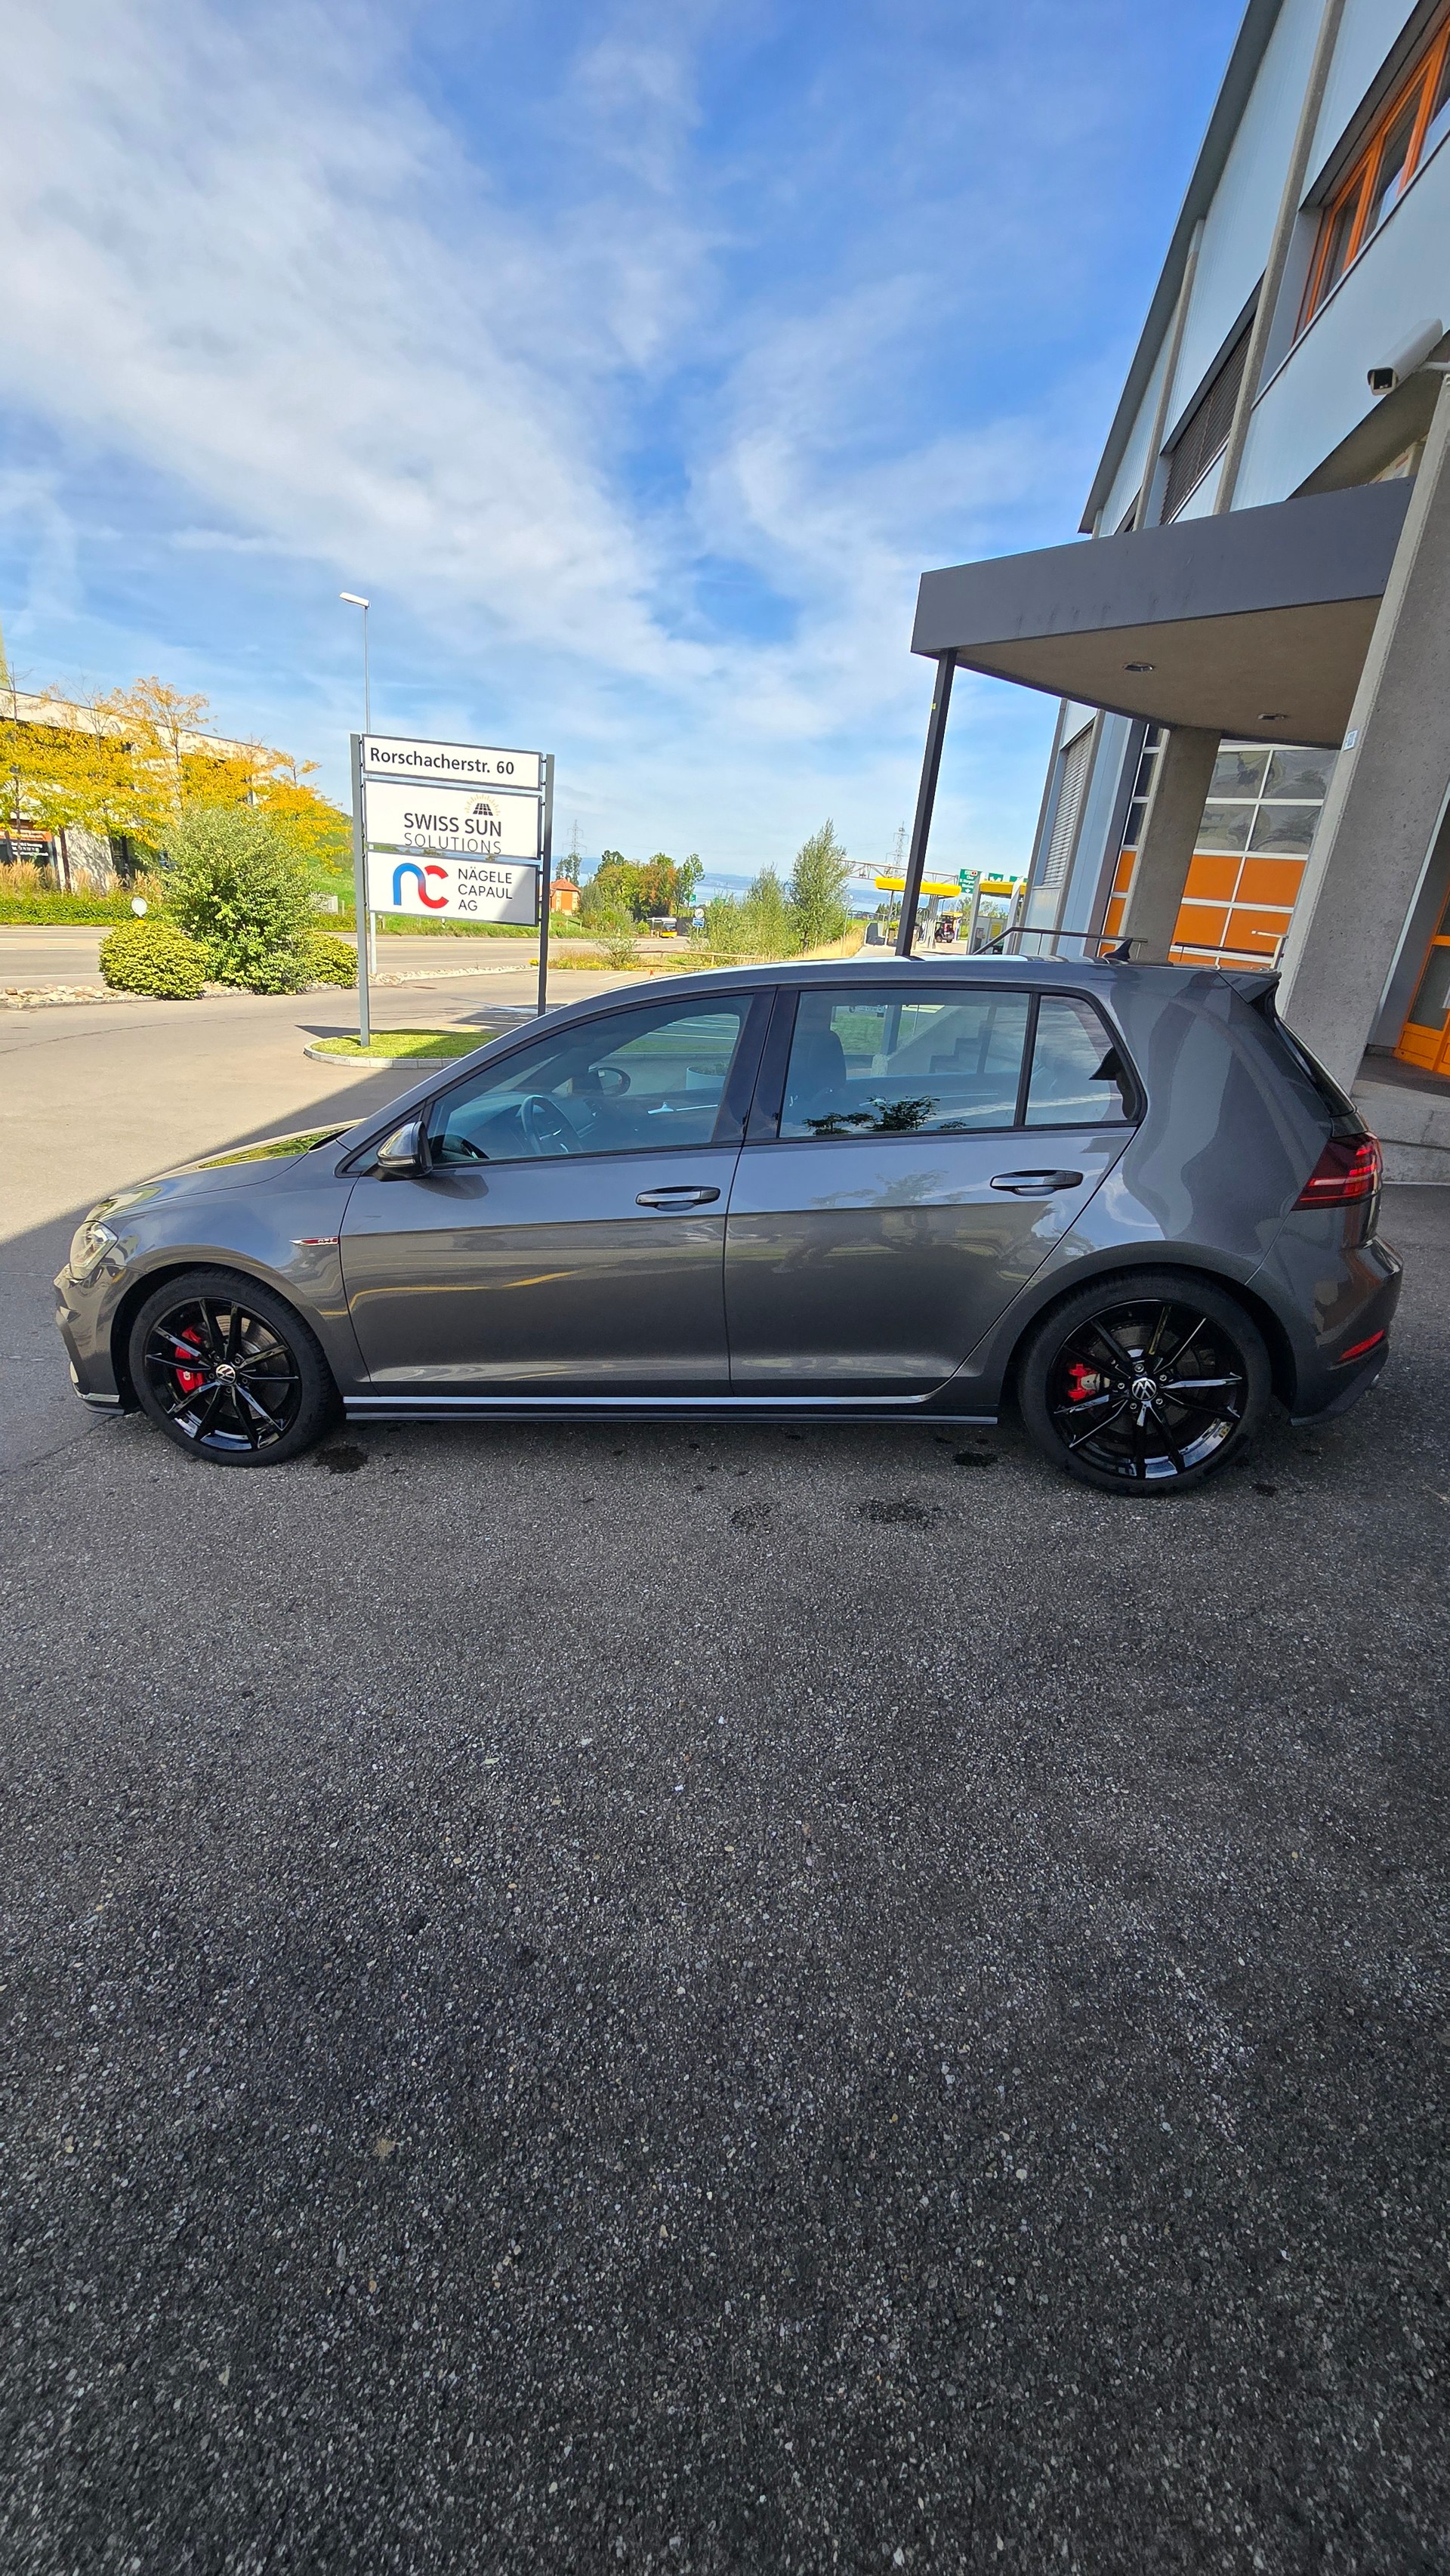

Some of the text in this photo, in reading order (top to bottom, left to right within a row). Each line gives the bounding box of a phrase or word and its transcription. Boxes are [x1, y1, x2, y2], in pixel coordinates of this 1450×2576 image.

[370, 747, 514, 774] Rorschacherstr. 60
[404, 813, 501, 836] SWISS SUN
[404, 832, 501, 854] SOLUTIONS
[458, 866, 512, 884] NÄGELE
[458, 884, 513, 899] CAPAUL
[458, 899, 478, 911] AG
